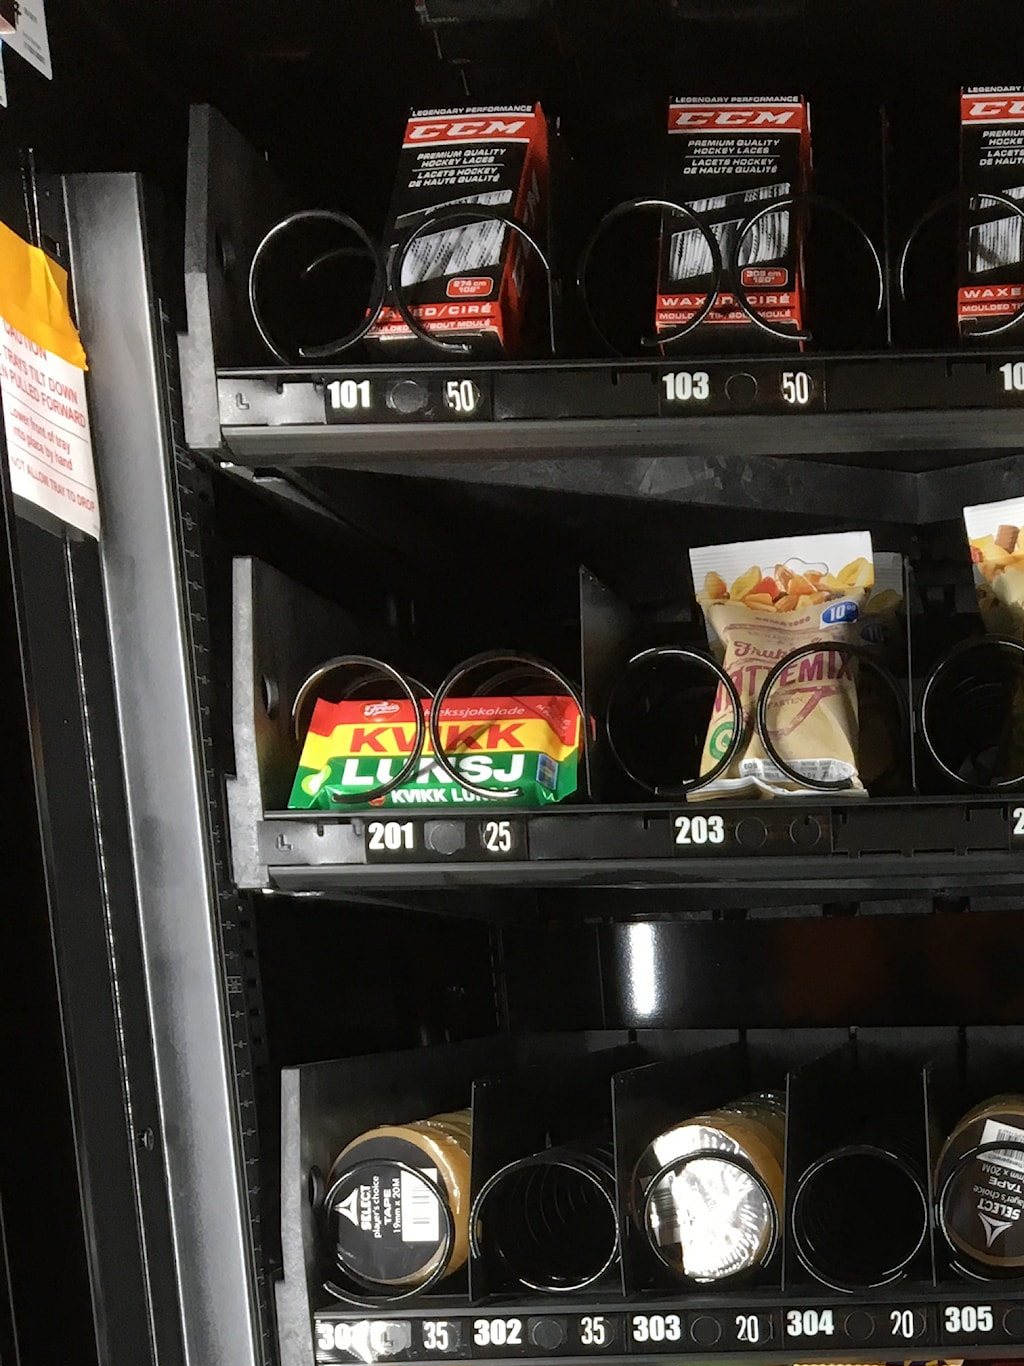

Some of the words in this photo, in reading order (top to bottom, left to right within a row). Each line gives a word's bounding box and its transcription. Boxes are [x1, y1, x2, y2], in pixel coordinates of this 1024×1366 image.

[412, 107, 464, 117] LEGENDARY
[466, 105, 532, 113] PERFORMANCE
[676, 112, 794, 125] CCM
[409, 121, 526, 139] CCM
[417, 151, 462, 160] PREMIUM
[463, 149, 506, 158] QUALITY
[421, 157, 461, 167] HOCKEY
[462, 156, 494, 164] LACES
[418, 169, 456, 179] LACETS
[457, 167, 497, 176] HOCKEY
[423, 177, 456, 186] HAUTE
[457, 174, 500, 184] QUALITÉ
[48, 377, 78, 404] DOWN
[327, 380, 371, 409] 101
[446, 379, 473, 412] 50
[662, 371, 710, 401] 103
[782, 371, 809, 405] 50
[42, 393, 86, 428] FORWARD
[830, 604, 845, 620] 10
[350, 723, 527, 752] KVIKK
[342, 754, 524, 785] LUNSJ
[392, 788, 448, 802] KVIKK
[368, 821, 414, 850] 201
[487, 821, 512, 852] 25
[674, 815, 725, 844] 203
[392, 1178, 400, 1198] 20M
[360, 1185, 371, 1230] SELECT
[977, 1198, 1021, 1220] SELECT
[373, 1207, 382, 1238] player's
[473, 1318, 522, 1346] 302
[580, 1316, 606, 1345] 35
[632, 1314, 681, 1342] 303
[735, 1315, 759, 1343] 20
[786, 1310, 835, 1337] 304
[890, 1310, 914, 1338] 20
[945, 1306, 994, 1333] 305
[423, 1321, 449, 1350] 35
